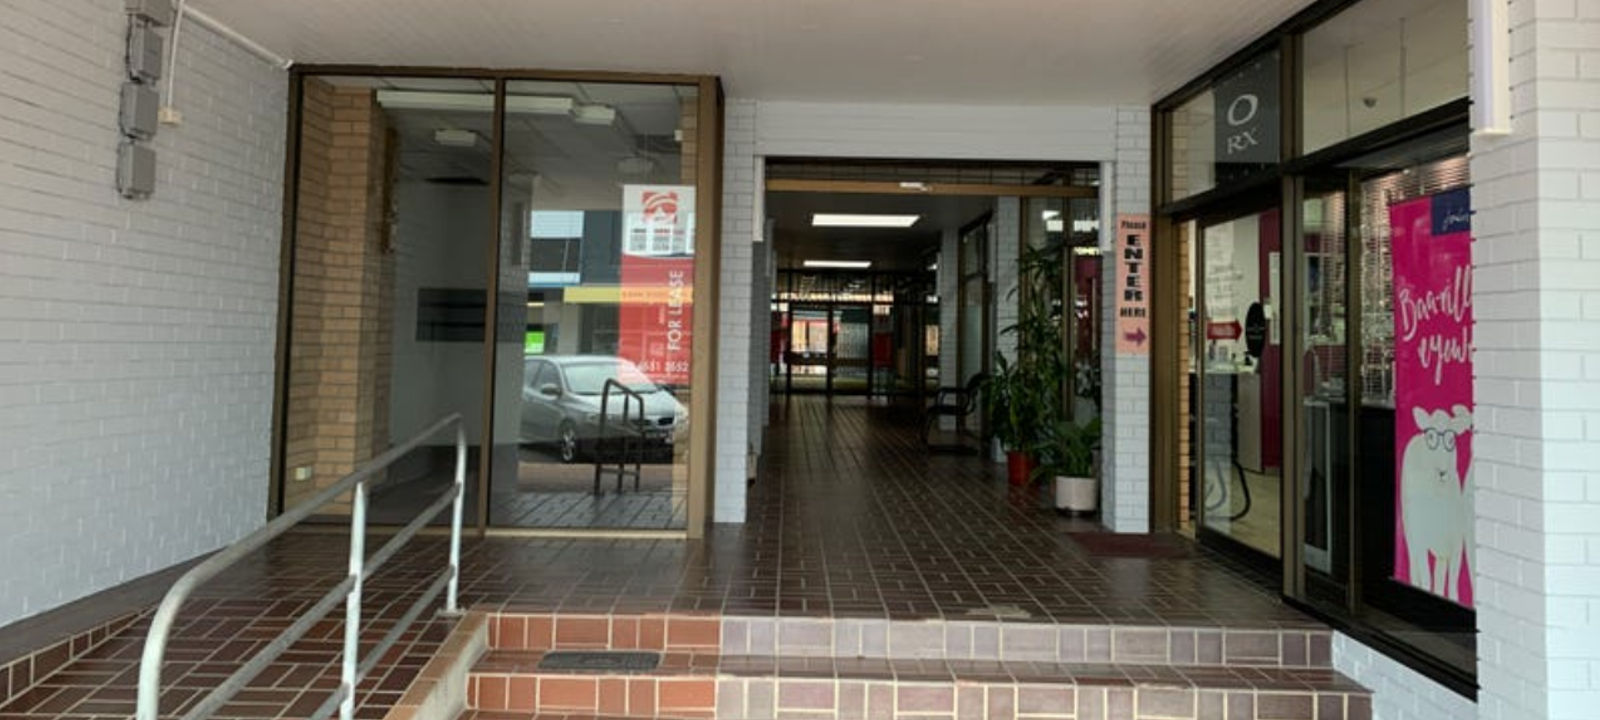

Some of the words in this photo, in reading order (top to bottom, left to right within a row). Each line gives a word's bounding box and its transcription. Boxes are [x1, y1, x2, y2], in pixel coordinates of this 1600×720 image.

[1227, 93, 1258, 126] O
[1227, 127, 1258, 154] RX
[1124, 234, 1144, 302] ENTER
[667, 271, 684, 315] LEASE
[1120, 307, 1146, 318] HERE
[667, 320, 682, 350] FOR
